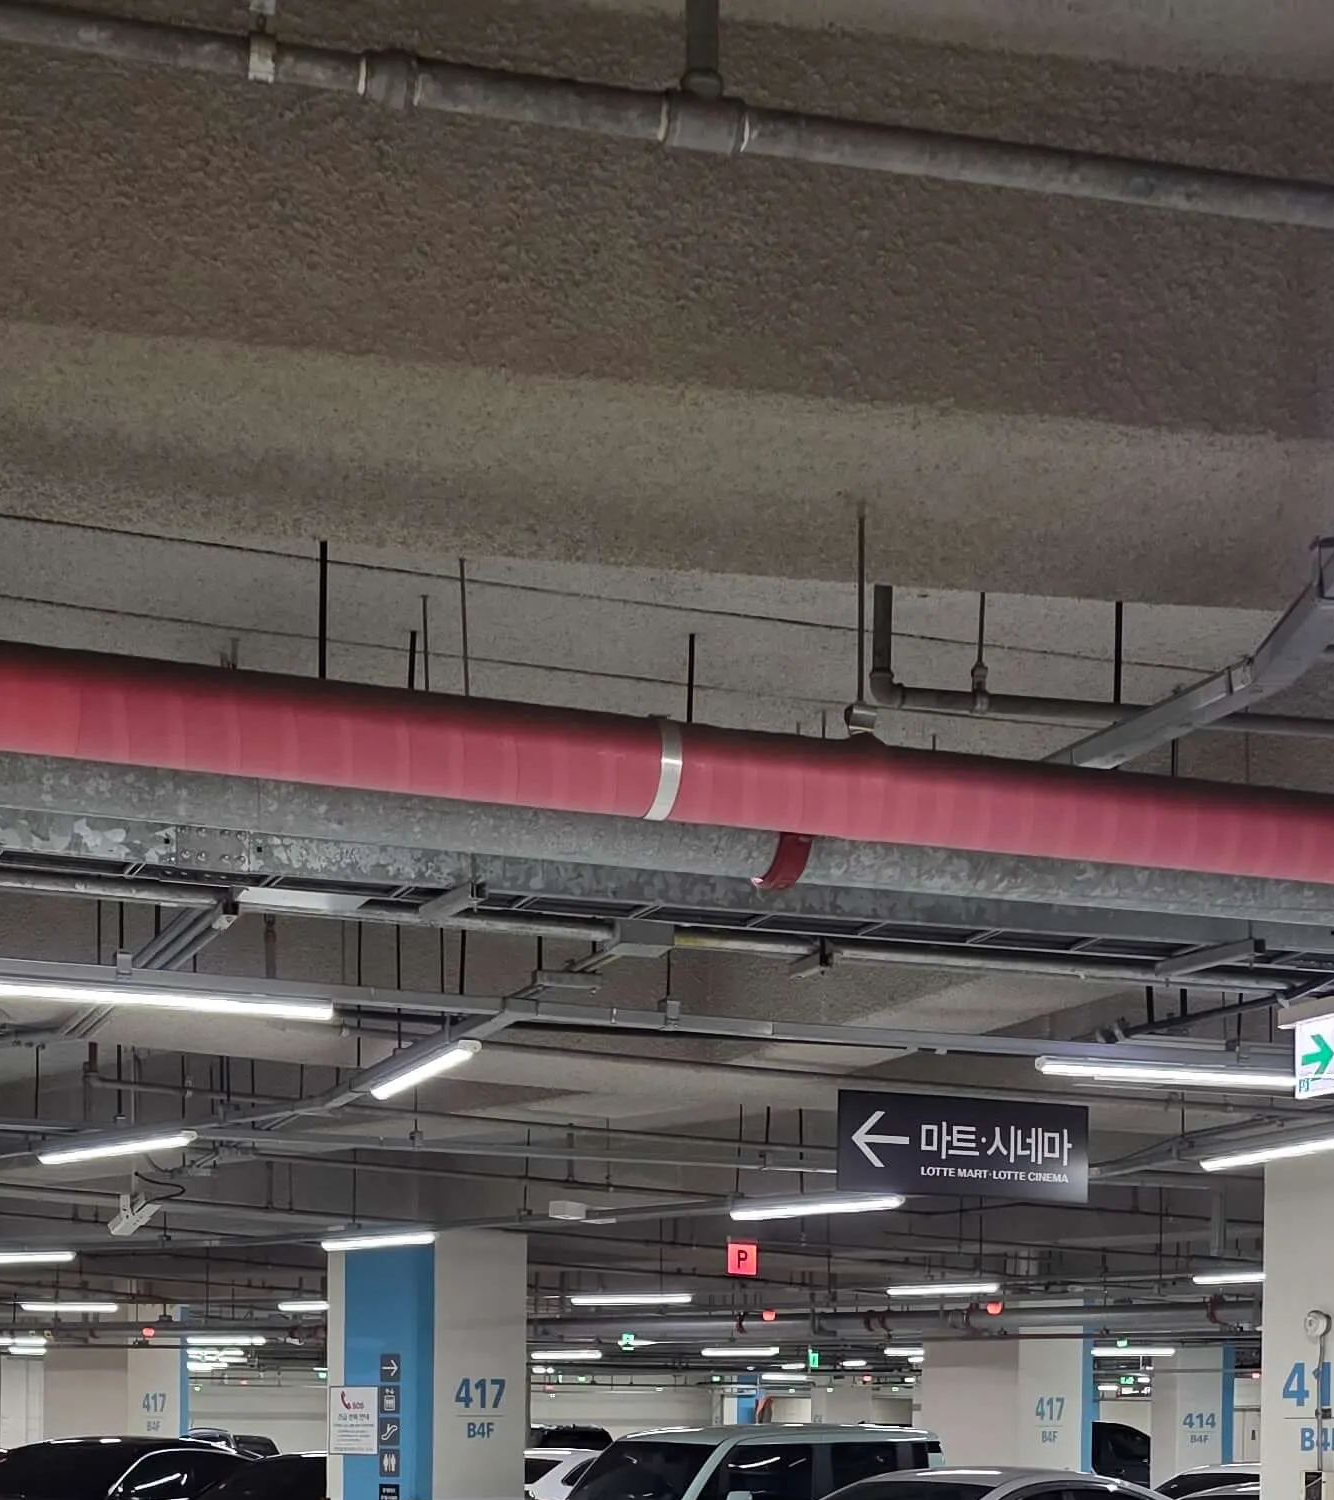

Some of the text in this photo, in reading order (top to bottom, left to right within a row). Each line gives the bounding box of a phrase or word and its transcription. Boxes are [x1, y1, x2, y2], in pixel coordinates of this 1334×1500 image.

[920, 1121, 1072, 1166] 마트·시네마
[920, 1167, 955, 1178] LOTTE
[1028, 1172, 1069, 1183] CINEMA
[737, 1249, 748, 1270] P
[455, 1378, 506, 1408] 417
[142, 1393, 167, 1412] 417
[1035, 1397, 1065, 1421] 417
[1182, 1413, 1216, 1429] 414
[467, 1422, 495, 1438] B4F
[1041, 1431, 1058, 1443] B4F
[1190, 1435, 1209, 1444] B4F
